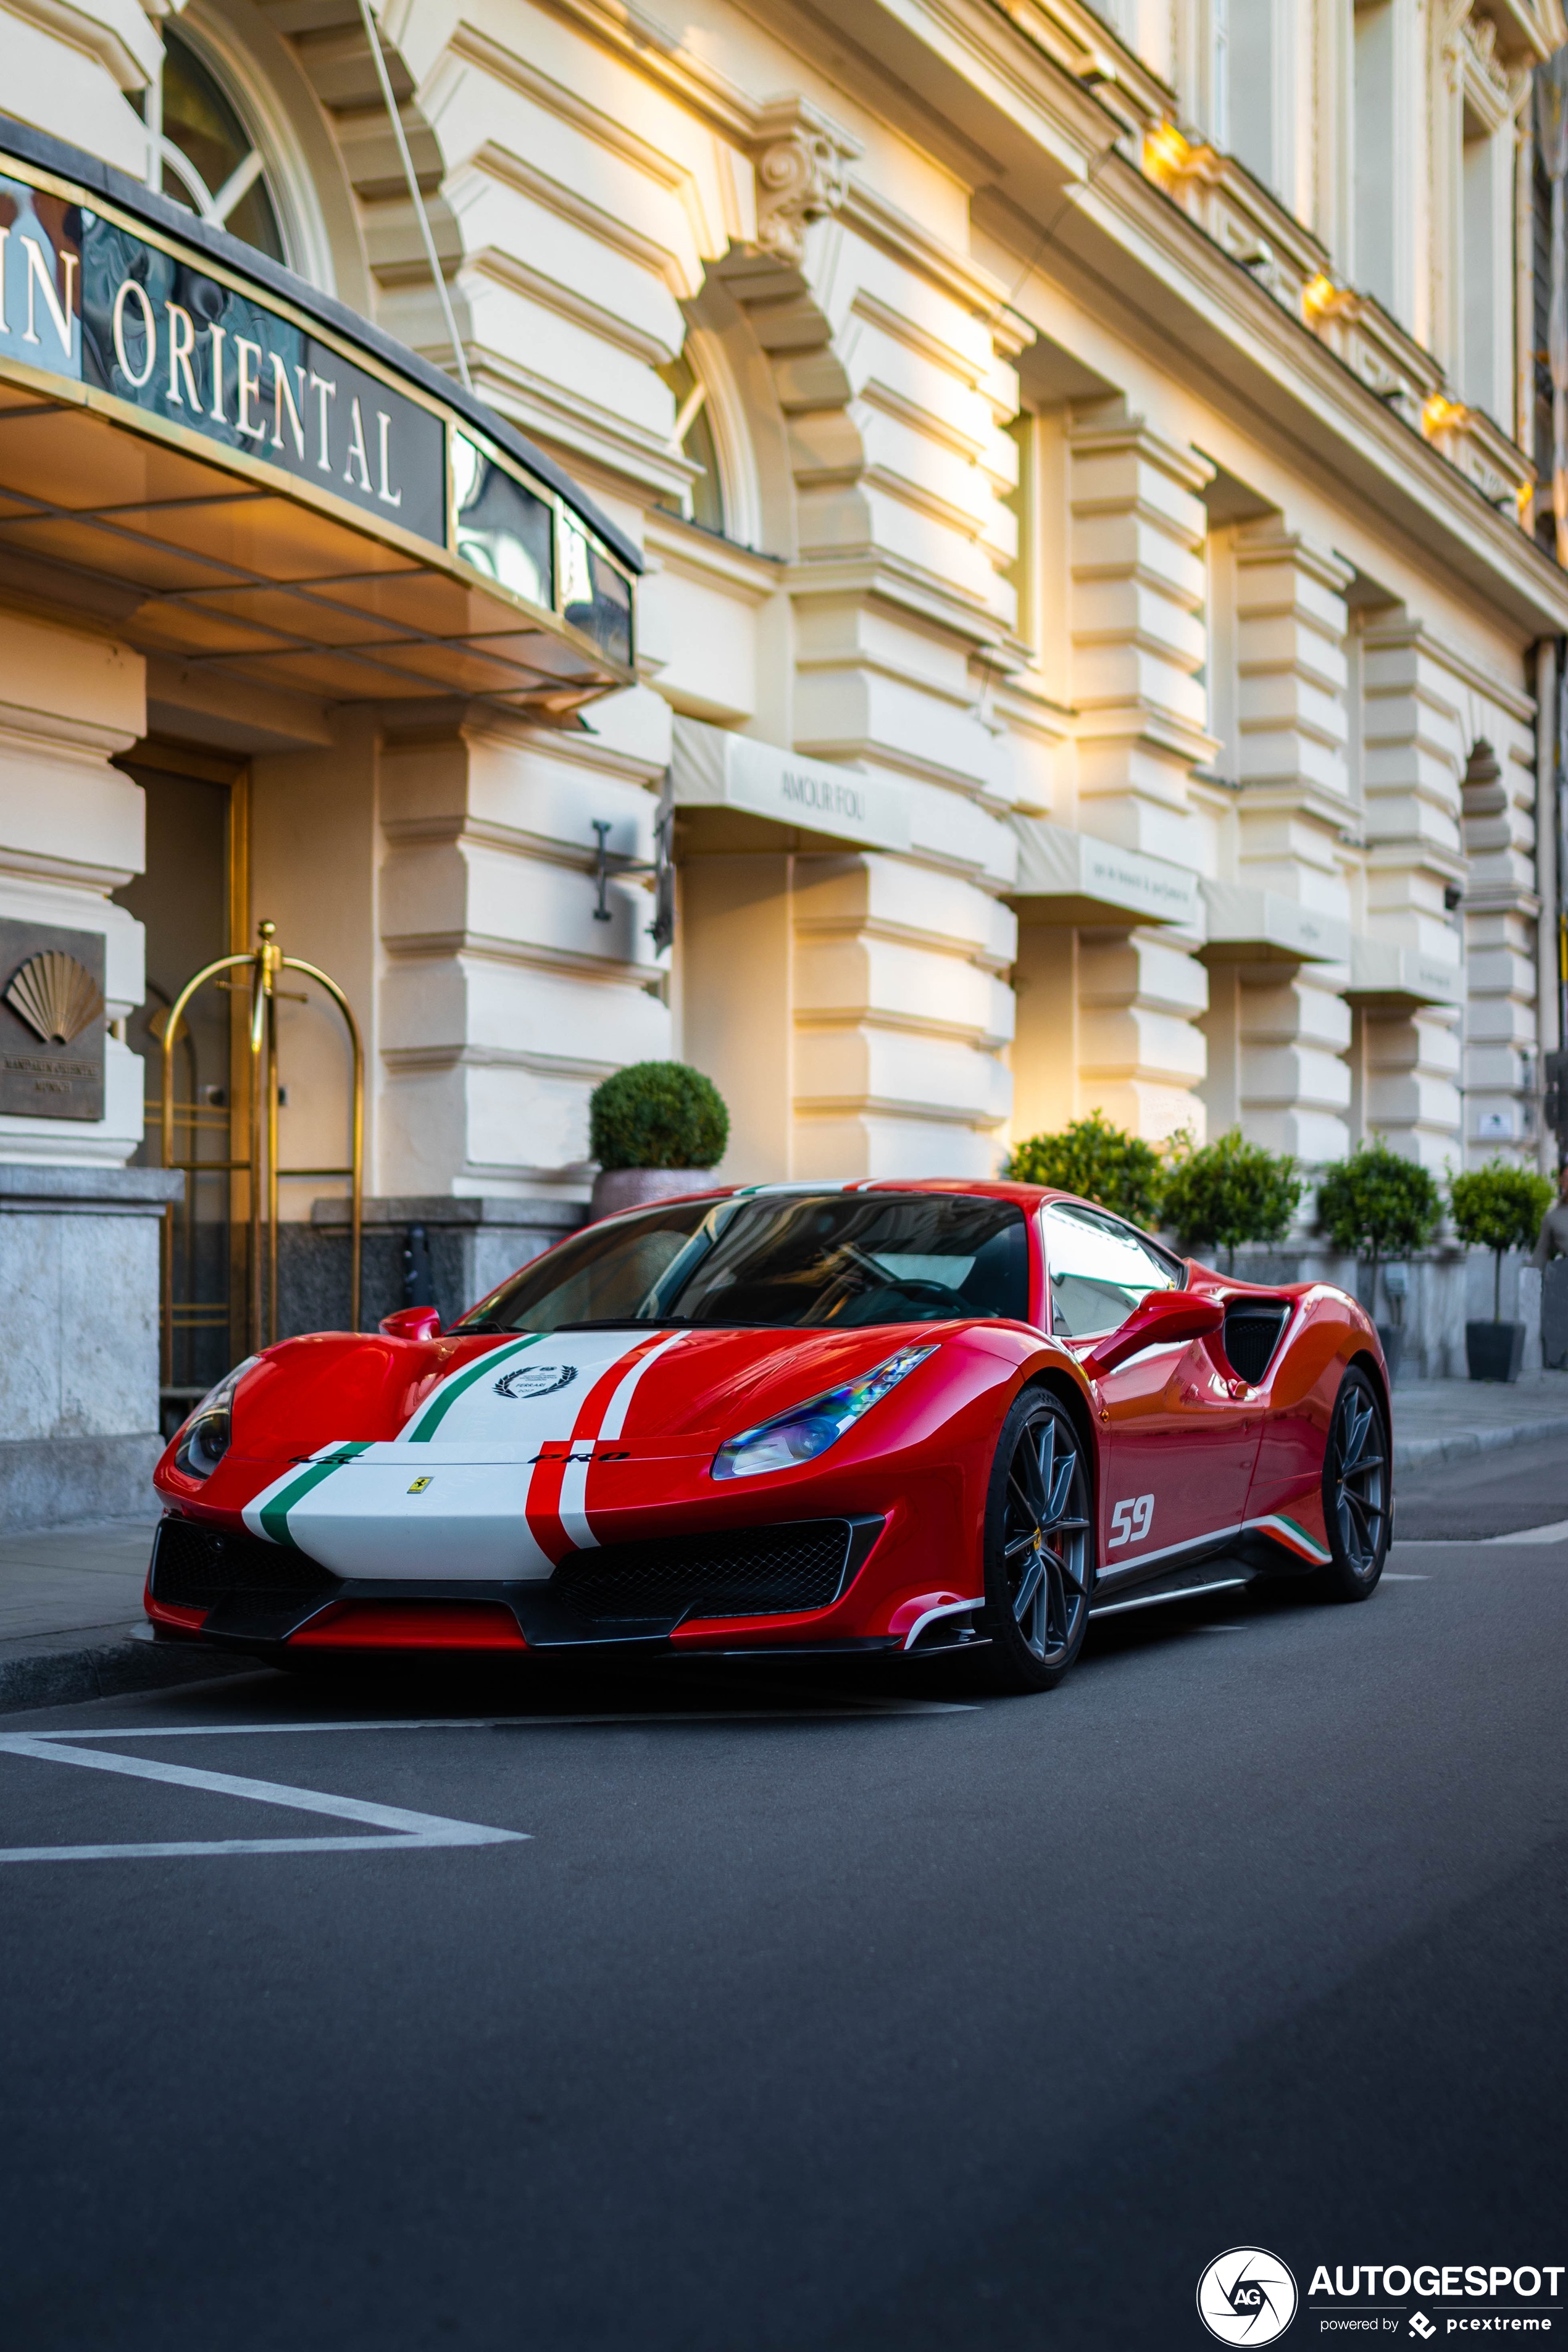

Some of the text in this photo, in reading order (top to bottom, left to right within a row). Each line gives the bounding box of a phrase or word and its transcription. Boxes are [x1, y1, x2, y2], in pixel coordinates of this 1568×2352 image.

[113, 280, 402, 507] ORIENTAL
[781, 770, 865, 821] AMOUR FOU
[527, 1451, 631, 1464] PRO
[1108, 1493, 1155, 1548] 59
